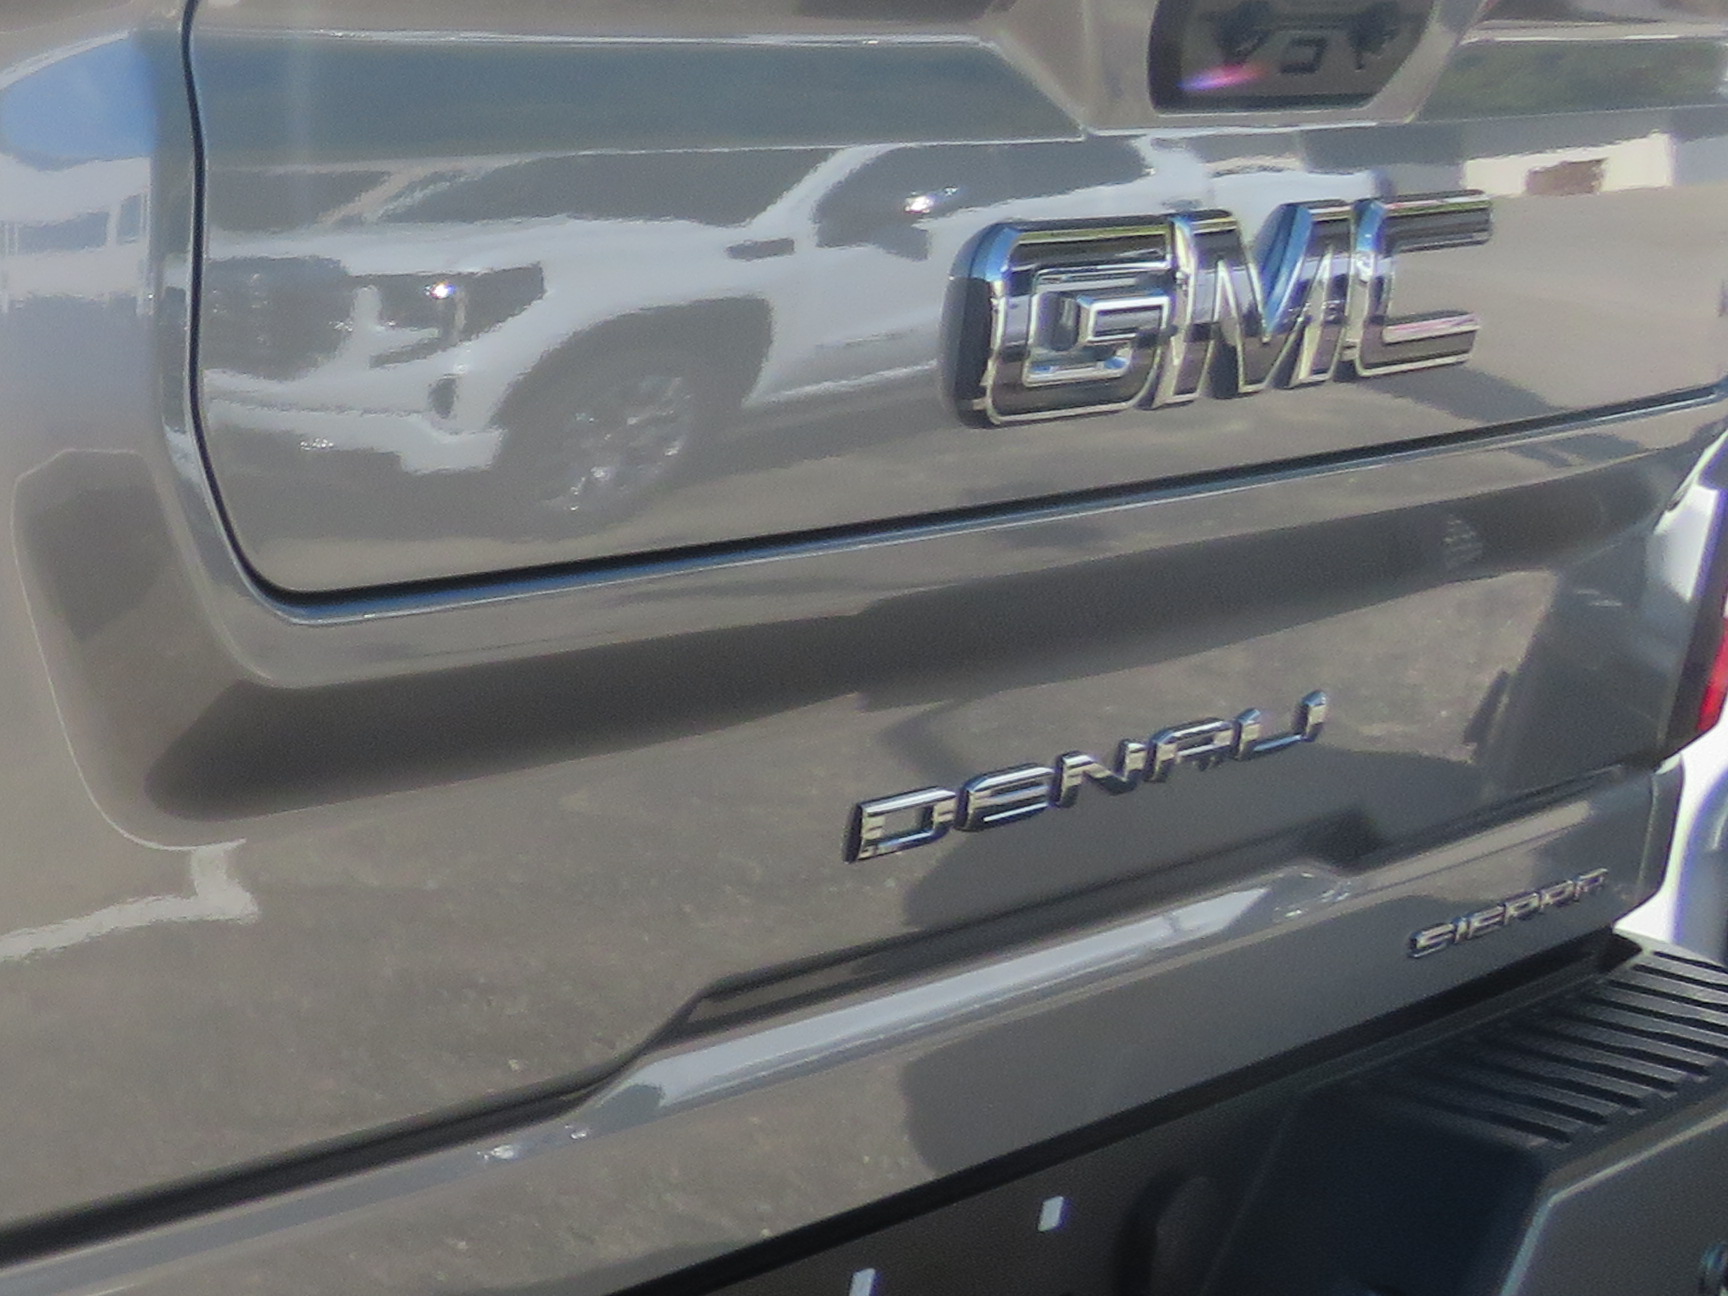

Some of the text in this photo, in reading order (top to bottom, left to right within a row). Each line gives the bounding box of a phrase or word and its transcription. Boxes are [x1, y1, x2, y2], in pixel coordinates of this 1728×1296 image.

[946, 188, 1493, 428] GMC
[841, 689, 1329, 864] DENALI
[1406, 866, 1610, 960] SIERRA
